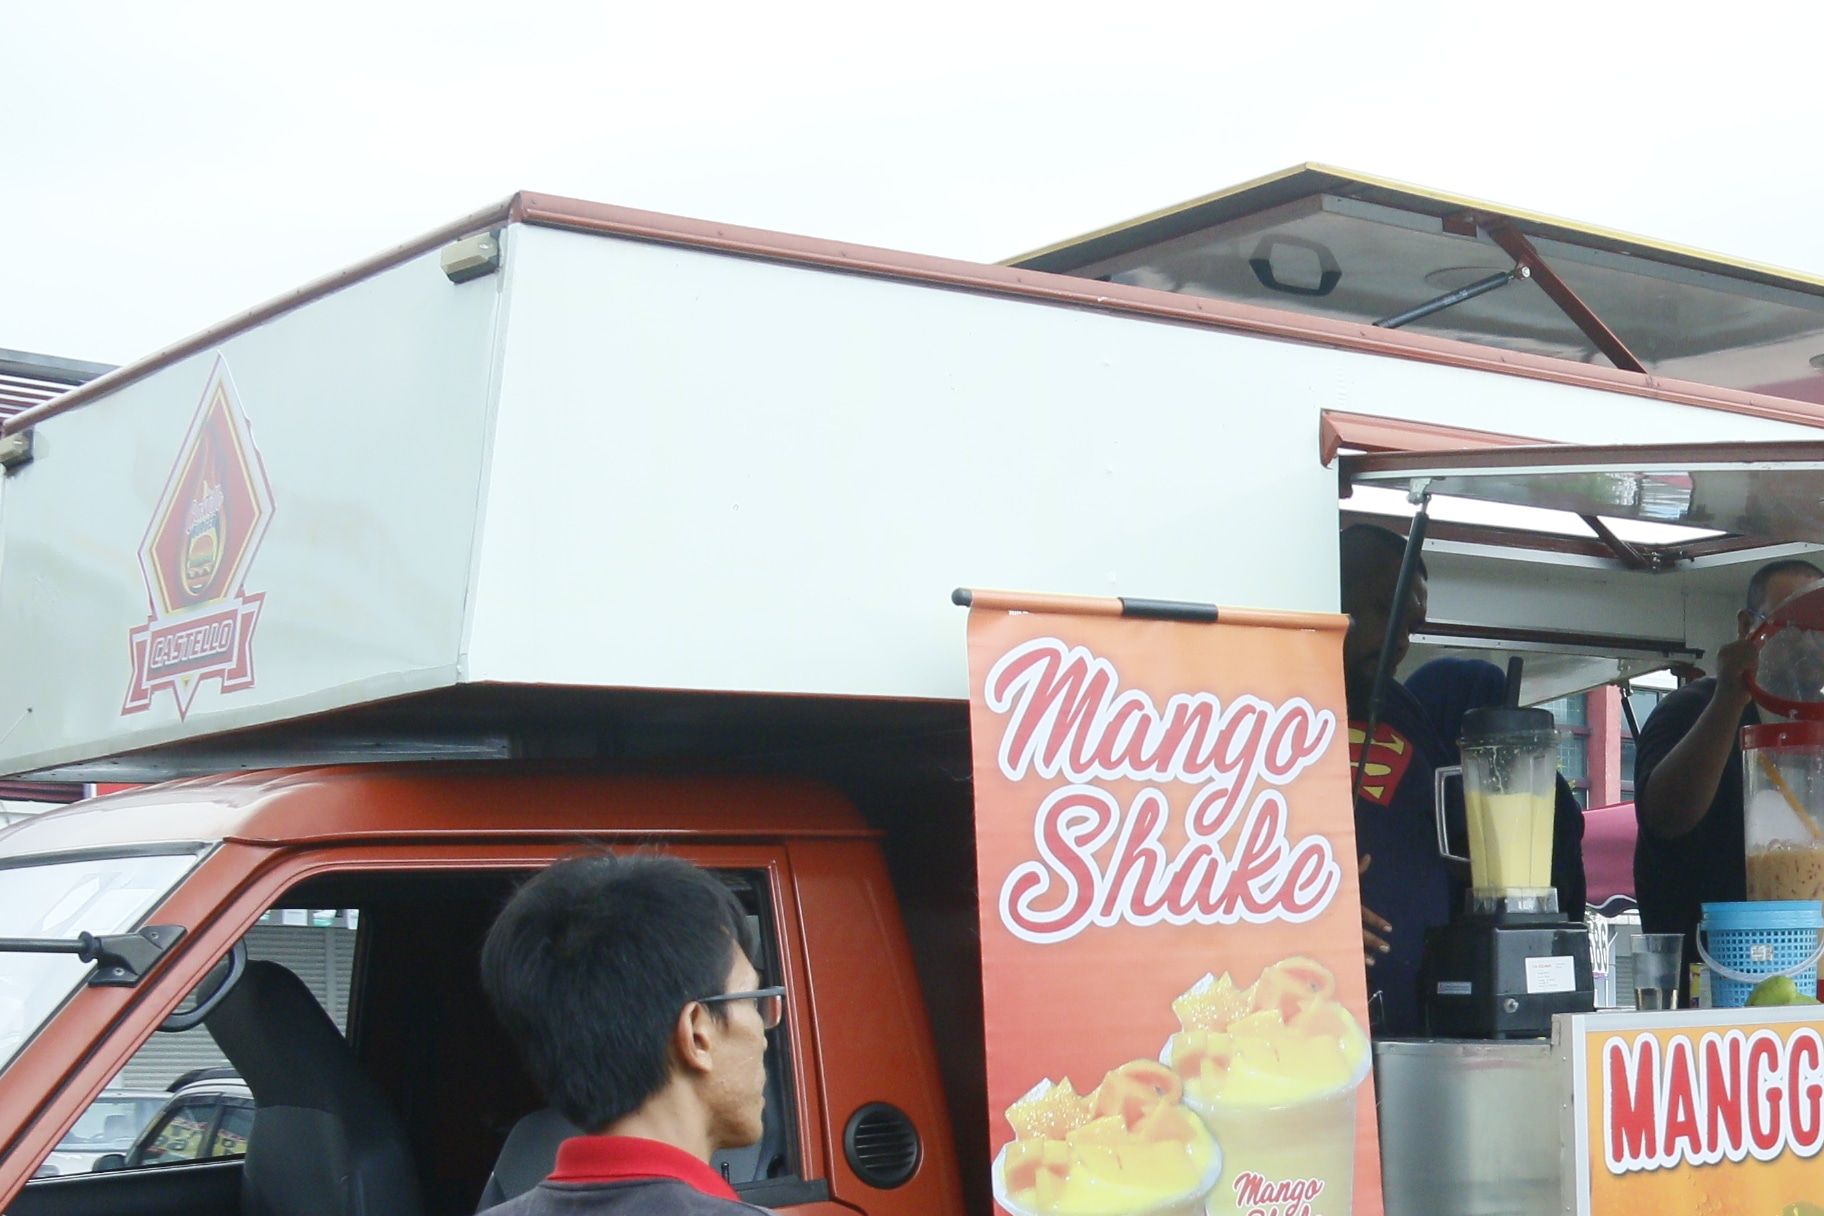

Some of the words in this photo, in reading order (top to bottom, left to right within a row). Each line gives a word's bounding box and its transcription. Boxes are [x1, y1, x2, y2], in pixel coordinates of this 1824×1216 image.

[151, 621, 232, 668] CASTELLO
[988, 640, 1333, 838] Mango
[1004, 788, 1338, 940] Shake
[1234, 1172, 1324, 1212] Mango
